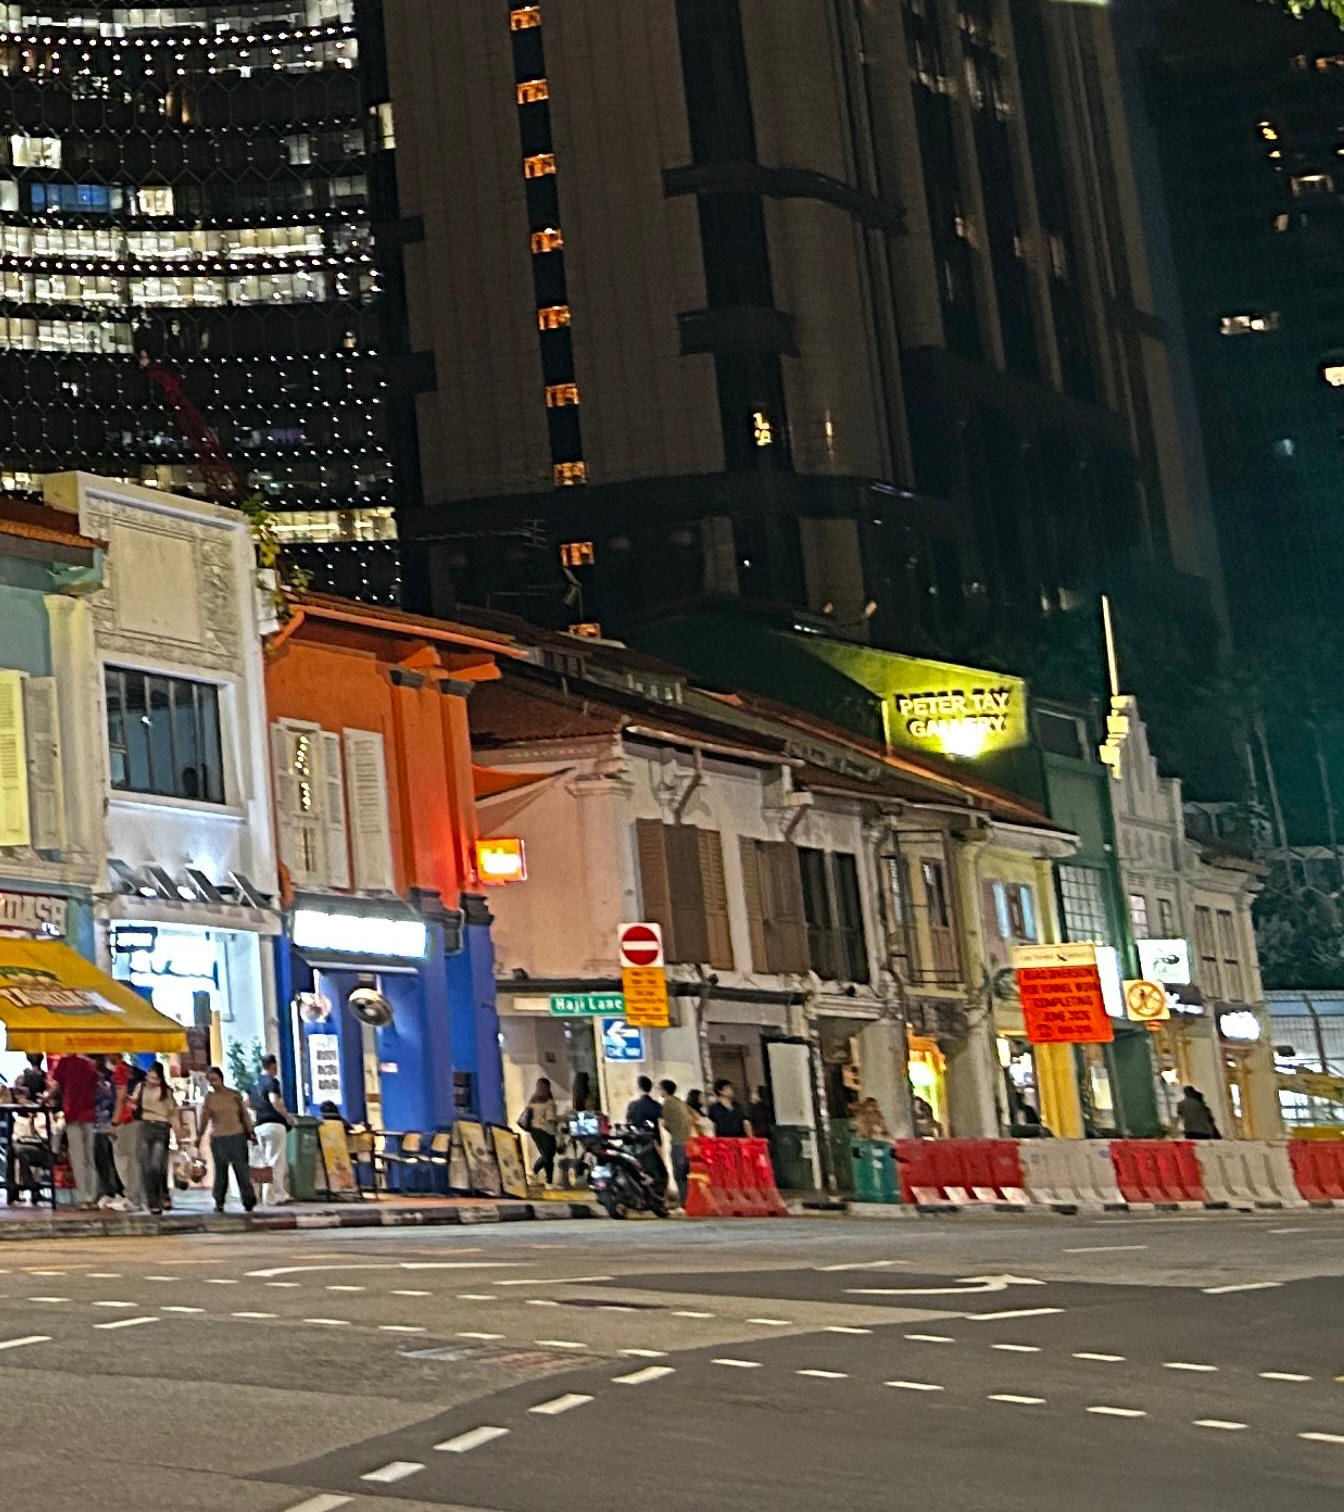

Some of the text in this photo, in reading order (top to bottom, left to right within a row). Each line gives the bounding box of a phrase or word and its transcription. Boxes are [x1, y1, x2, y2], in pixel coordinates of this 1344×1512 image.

[899, 693, 1009, 716] PETER TAY
[909, 716, 1005, 738] GALLERY
[555, 997, 623, 1012] Haji Lane
